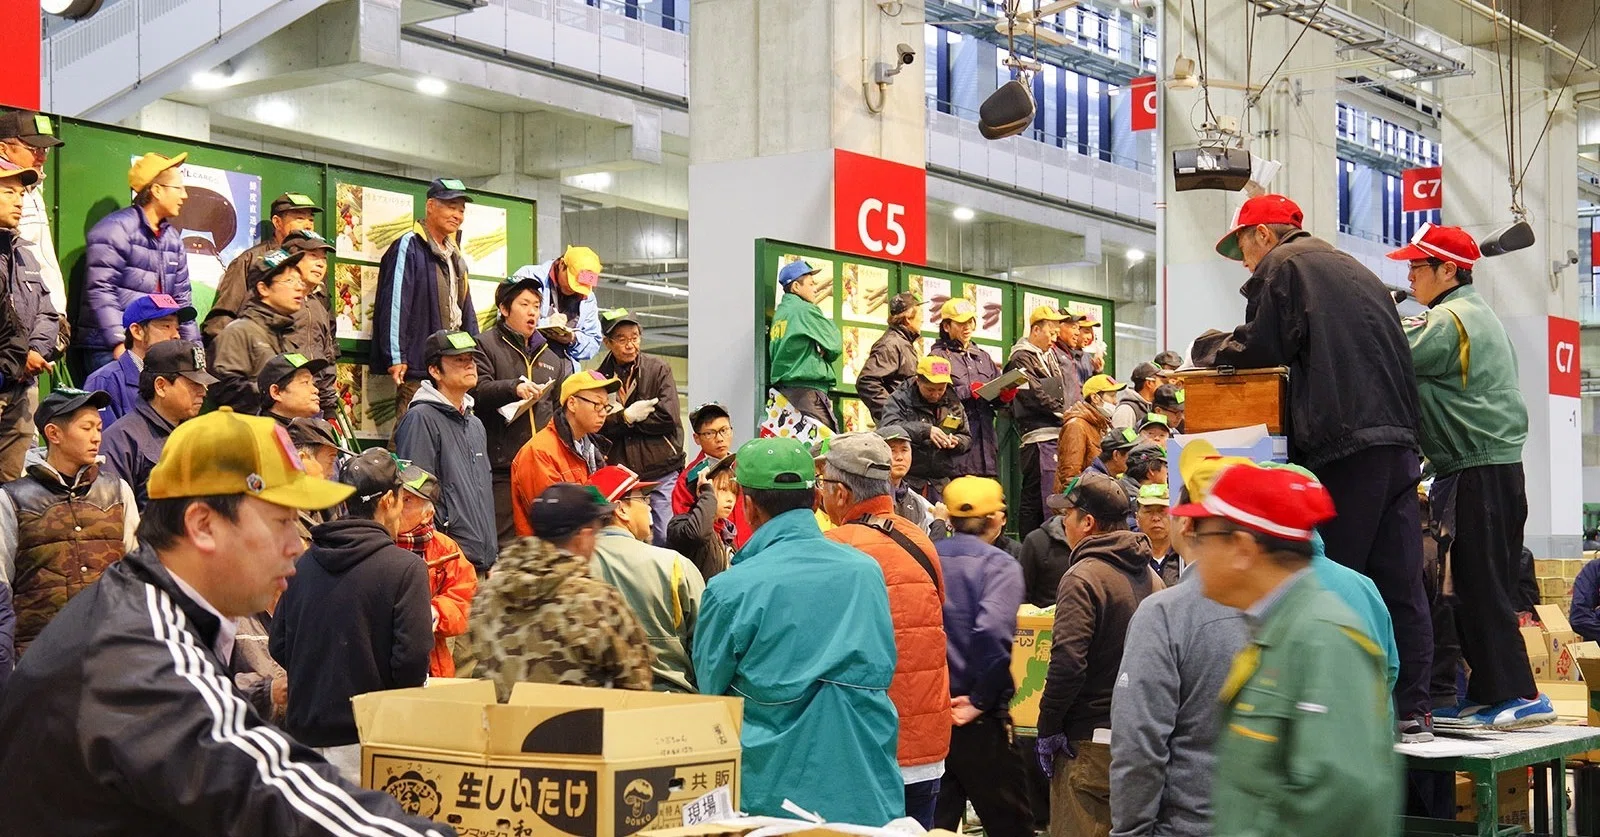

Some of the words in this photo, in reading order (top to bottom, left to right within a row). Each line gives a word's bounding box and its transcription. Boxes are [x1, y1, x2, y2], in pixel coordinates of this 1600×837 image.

[1413, 178, 1441, 199] C7
[857, 197, 907, 256] C5
[1555, 341, 1574, 373] C7
[691, 769, 730, 790] 共販
[455, 771, 589, 818] 生しいたけ
[625, 814, 652, 826] DONKO
[687, 794, 717, 825] 現場
[452, 825, 508, 837] ンマッシュ
